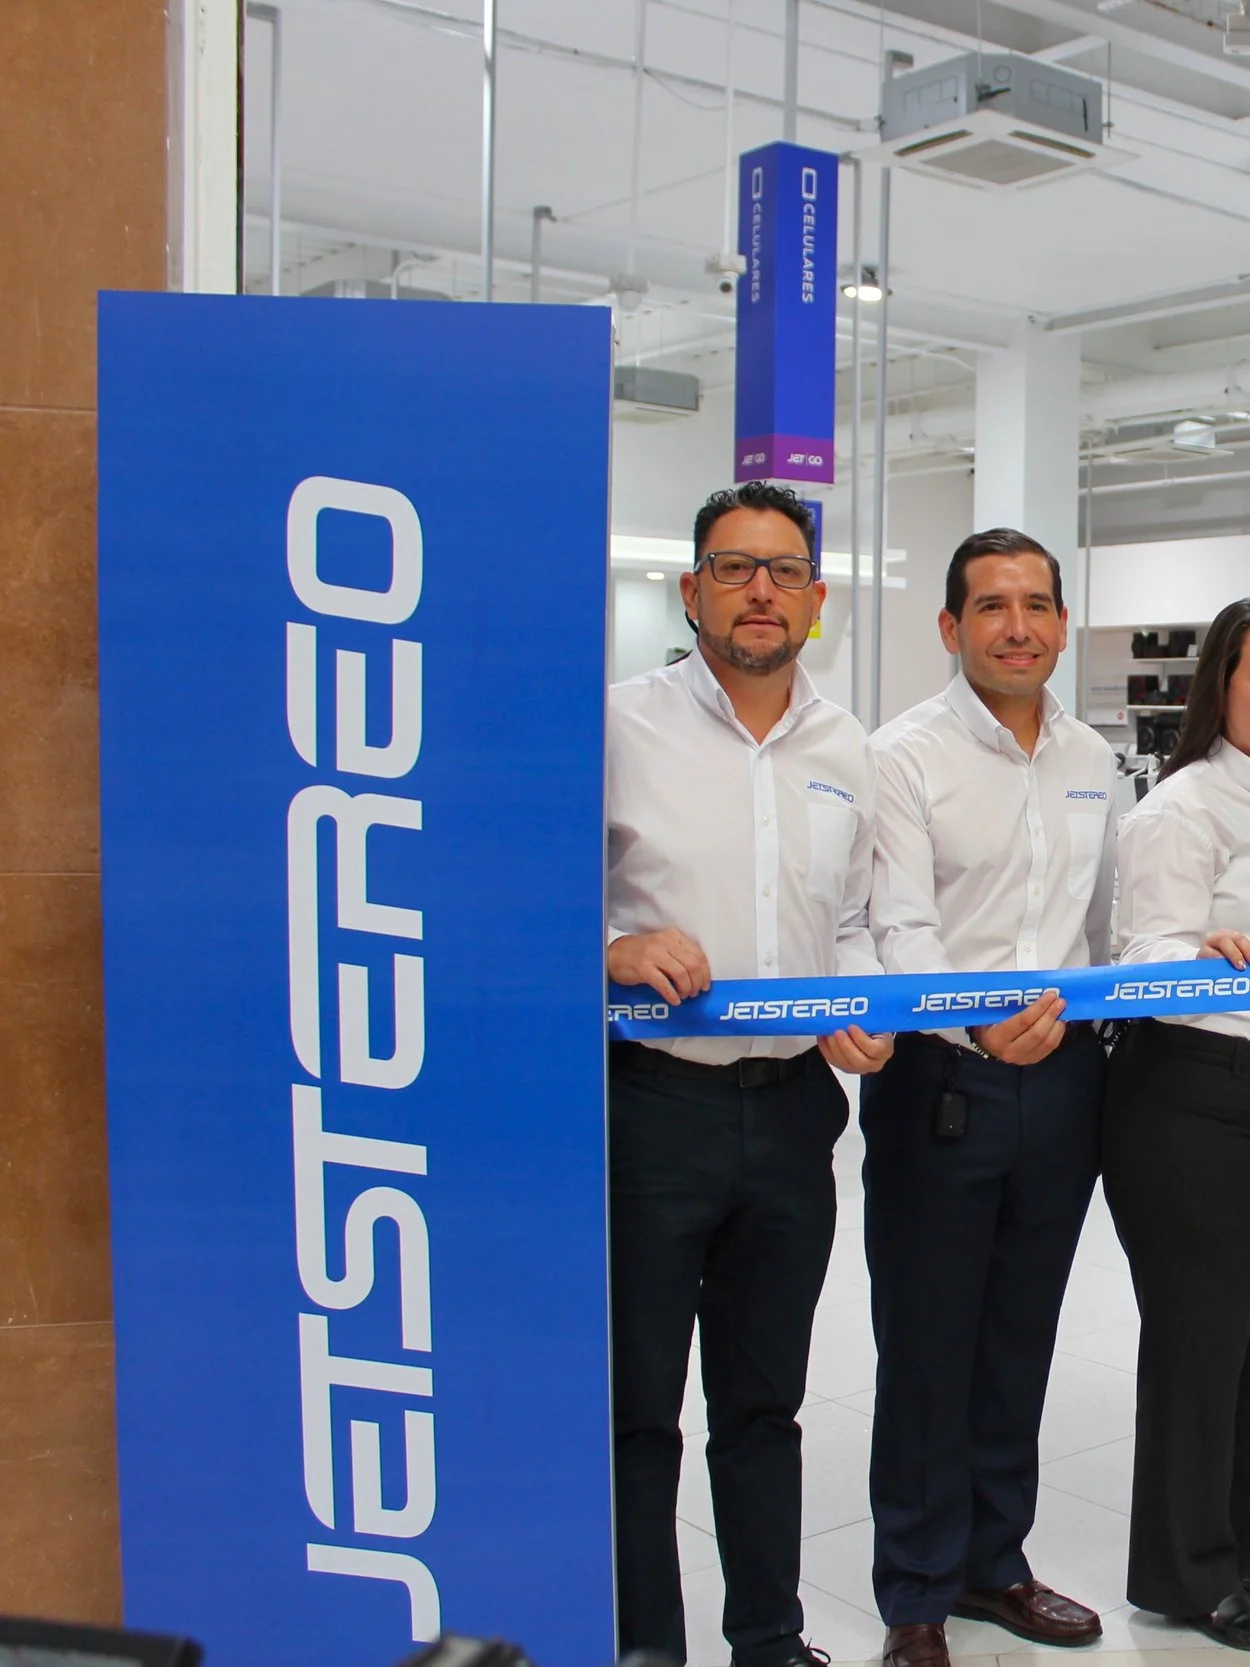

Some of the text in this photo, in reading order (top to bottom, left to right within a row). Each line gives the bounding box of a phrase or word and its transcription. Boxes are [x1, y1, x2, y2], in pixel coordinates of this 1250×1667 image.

[752, 203, 762, 304] CELULARES
[802, 203, 815, 304] CELULARES
[1065, 790, 1107, 800] JETSTEREO
[720, 997, 869, 1021] JETSTEREO
[1105, 977, 1250, 1000] JETSTEREO
[287, 476, 441, 1642] JETSTEREO
